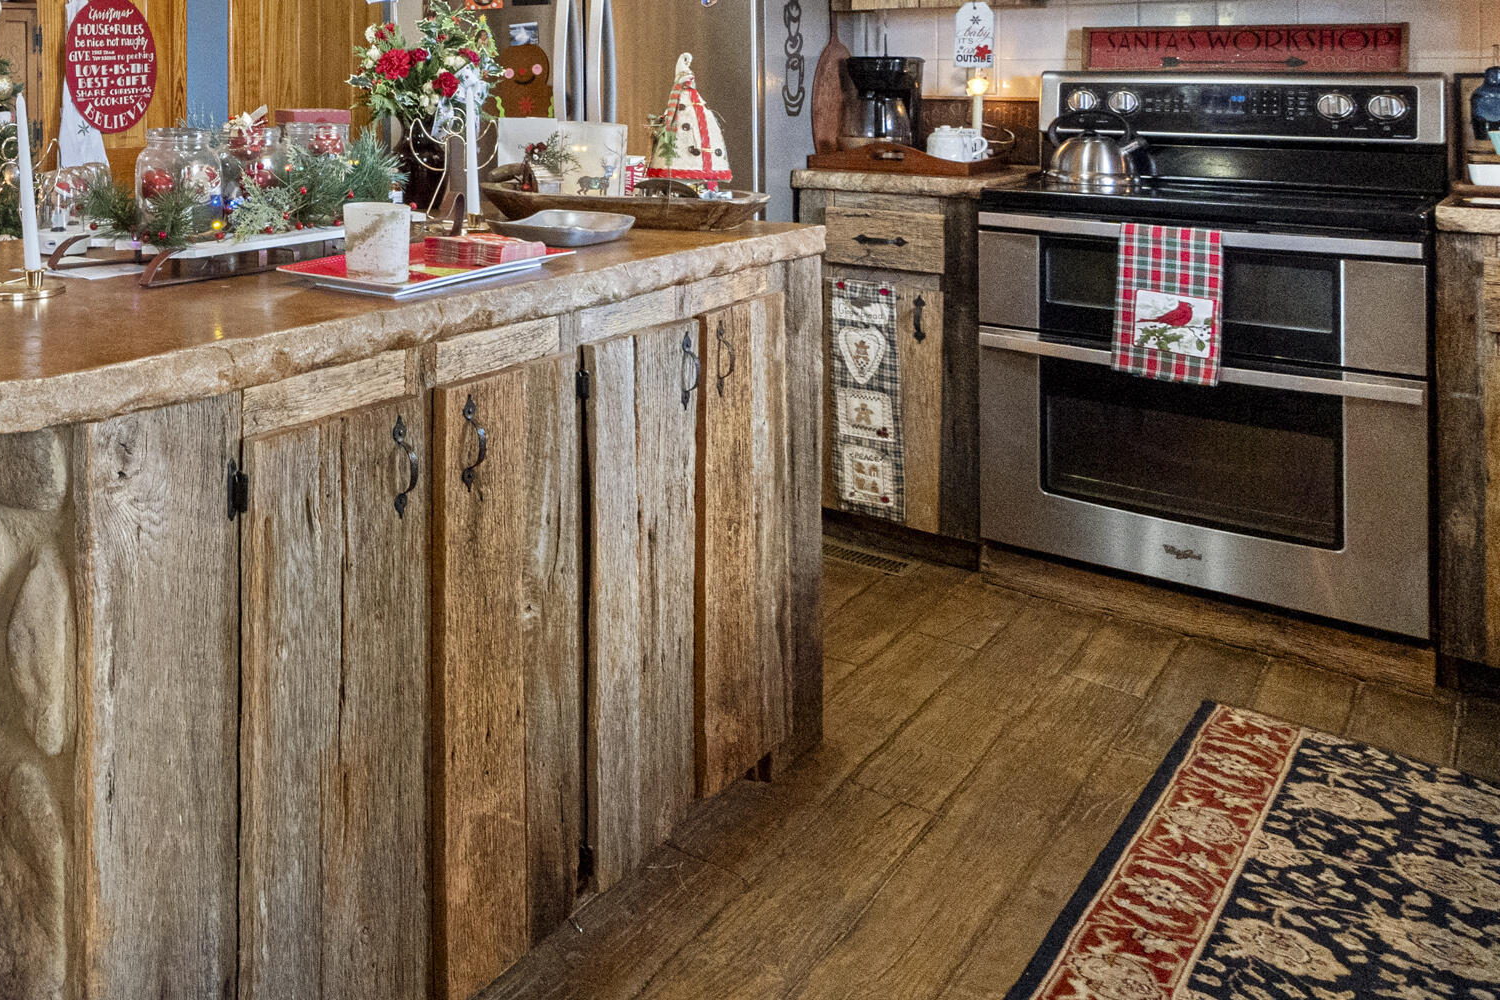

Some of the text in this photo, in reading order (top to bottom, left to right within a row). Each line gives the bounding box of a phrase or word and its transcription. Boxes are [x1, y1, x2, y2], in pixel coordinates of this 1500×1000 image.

[88, 6, 134, 23] Christmas
[77, 23, 144, 36] HOUSE RULES
[75, 36, 149, 50] be nice not naughty
[1207, 29, 1394, 52] WORKSHOP
[69, 51, 90, 62] GIVE
[126, 51, 154, 63] peeking
[75, 63, 151, 77] LOVE IS THE
[78, 75, 148, 89] BEST GIFT
[76, 85, 152, 97] SHARE CHRISTMAS
[94, 95, 135, 107] COOKIES
[84, 99, 147, 129] BELIEVE
